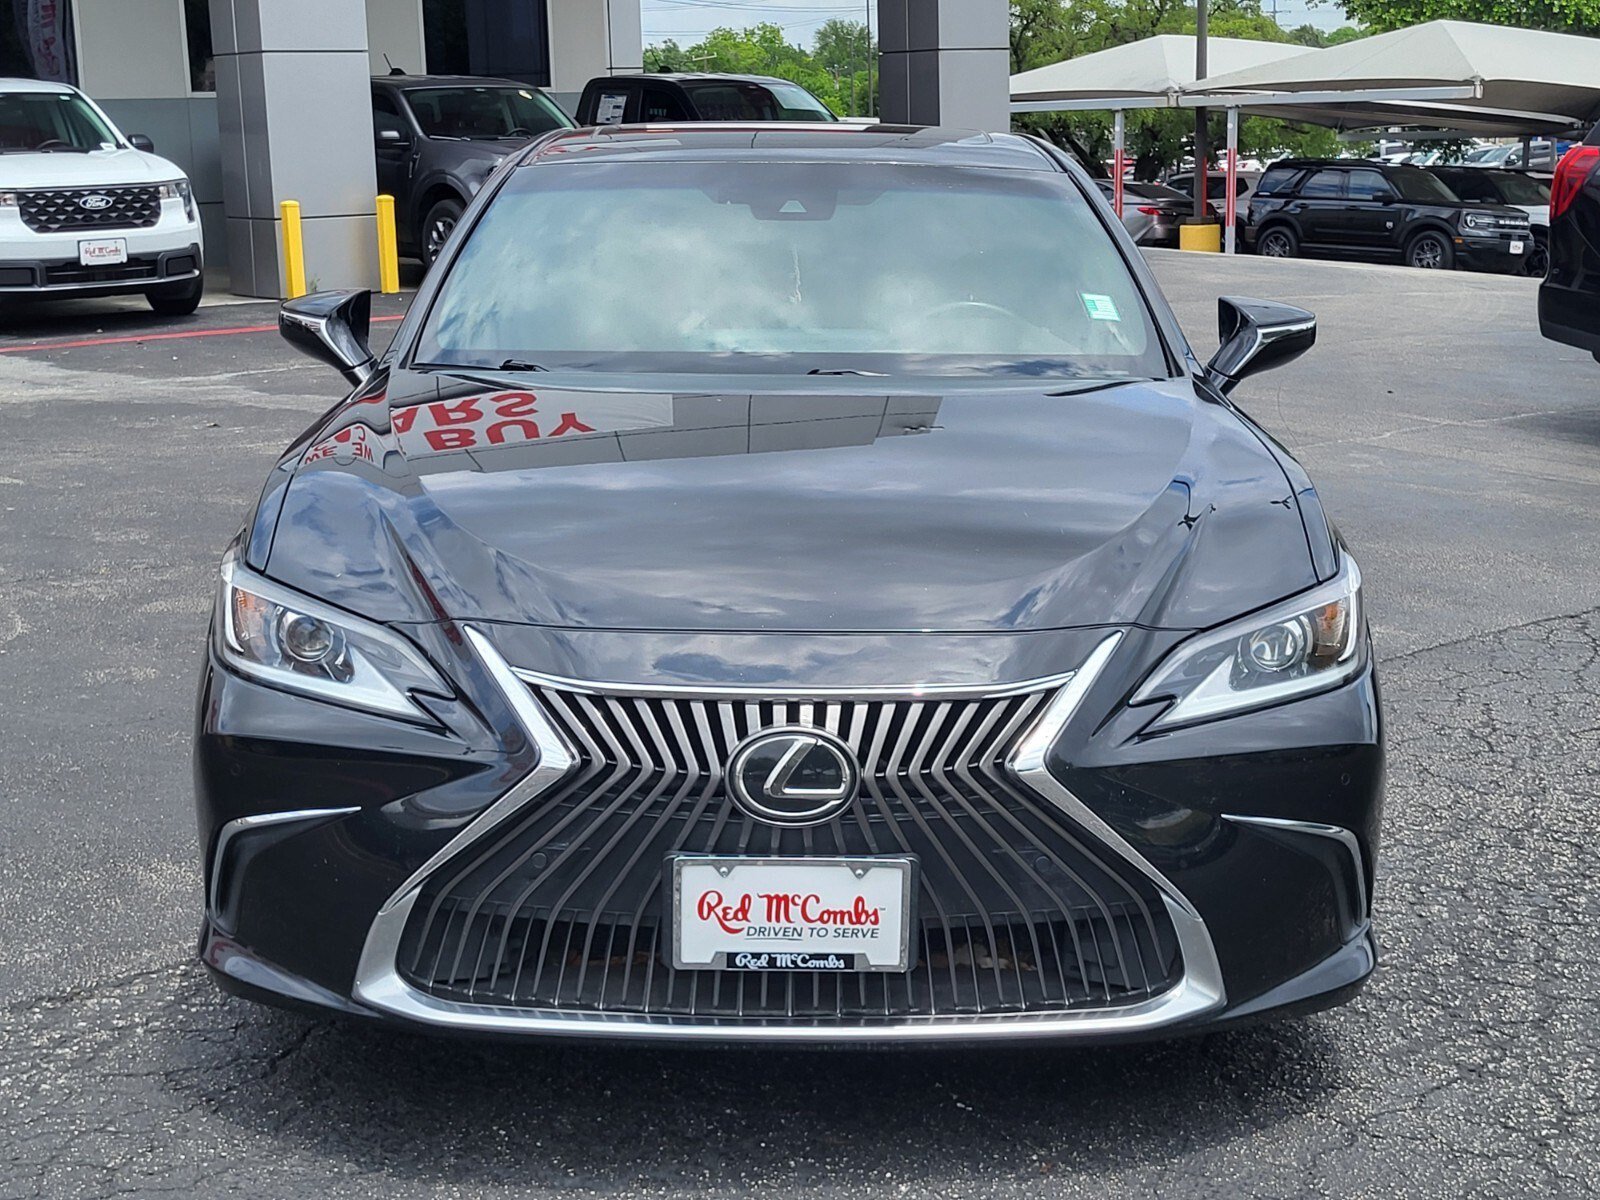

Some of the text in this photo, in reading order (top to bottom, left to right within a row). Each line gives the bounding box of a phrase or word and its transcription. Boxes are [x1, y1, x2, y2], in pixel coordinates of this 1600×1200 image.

[697, 889, 880, 935] Red McCombs
[746, 926, 880, 939] DRIVEN TO SERVE
[735, 952, 845, 970] Red McCombs
